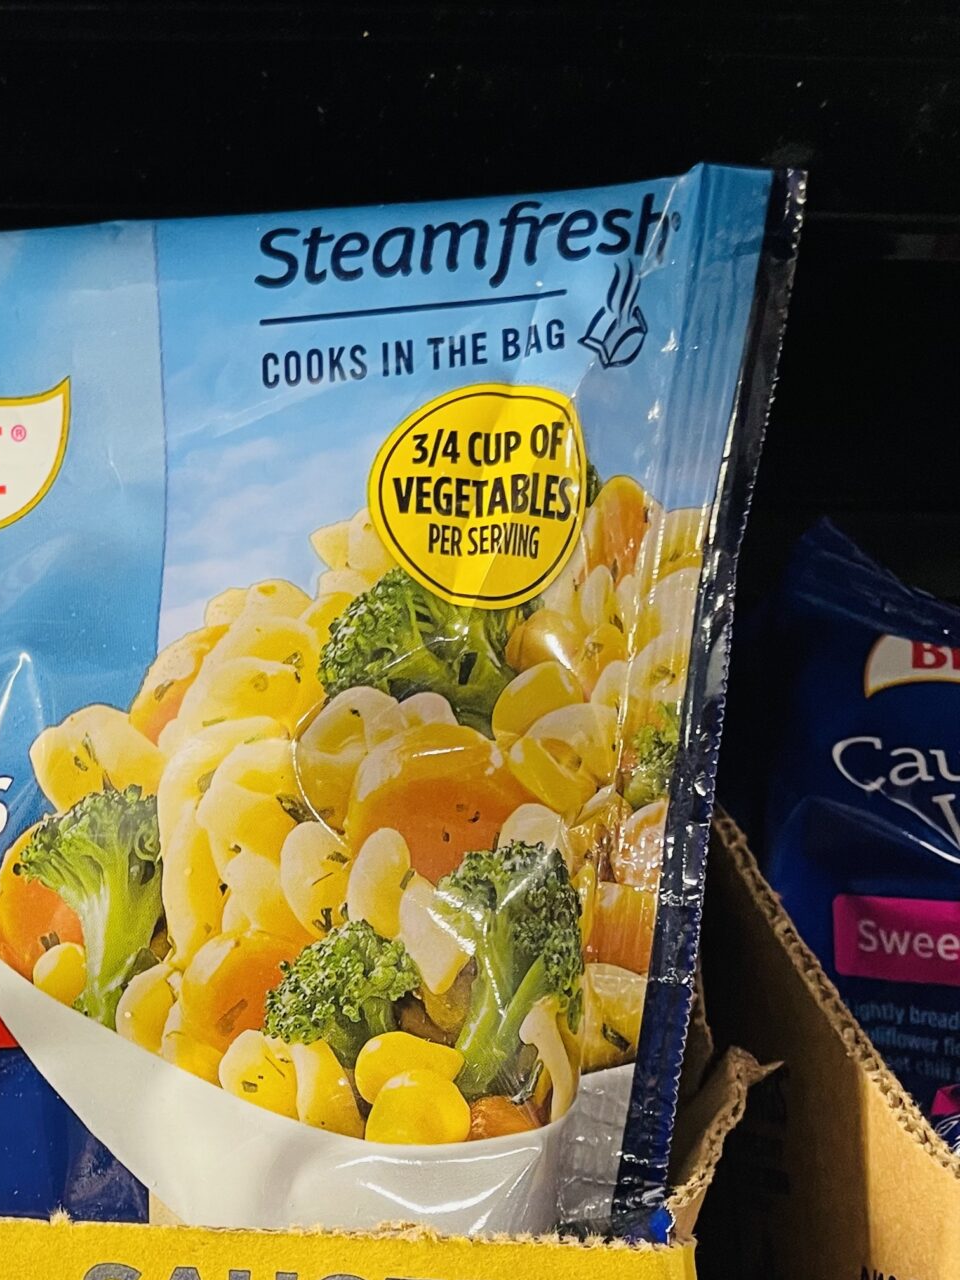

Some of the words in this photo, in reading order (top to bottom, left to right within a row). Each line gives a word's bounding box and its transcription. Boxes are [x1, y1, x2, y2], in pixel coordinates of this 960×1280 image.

[254, 193, 669, 288] Steamfresh
[261, 344, 368, 389] COOKS
[382, 340, 413, 377] IN
[427, 331, 488, 371] THE
[502, 319, 566, 361] BAG
[412, 429, 460, 467] 3/4
[468, 431, 521, 467] CUP
[530, 422, 564, 460] OF
[393, 473, 574, 522] VEGETABLES
[428, 523, 462, 557] PER
[467, 523, 540, 559] SERVING
